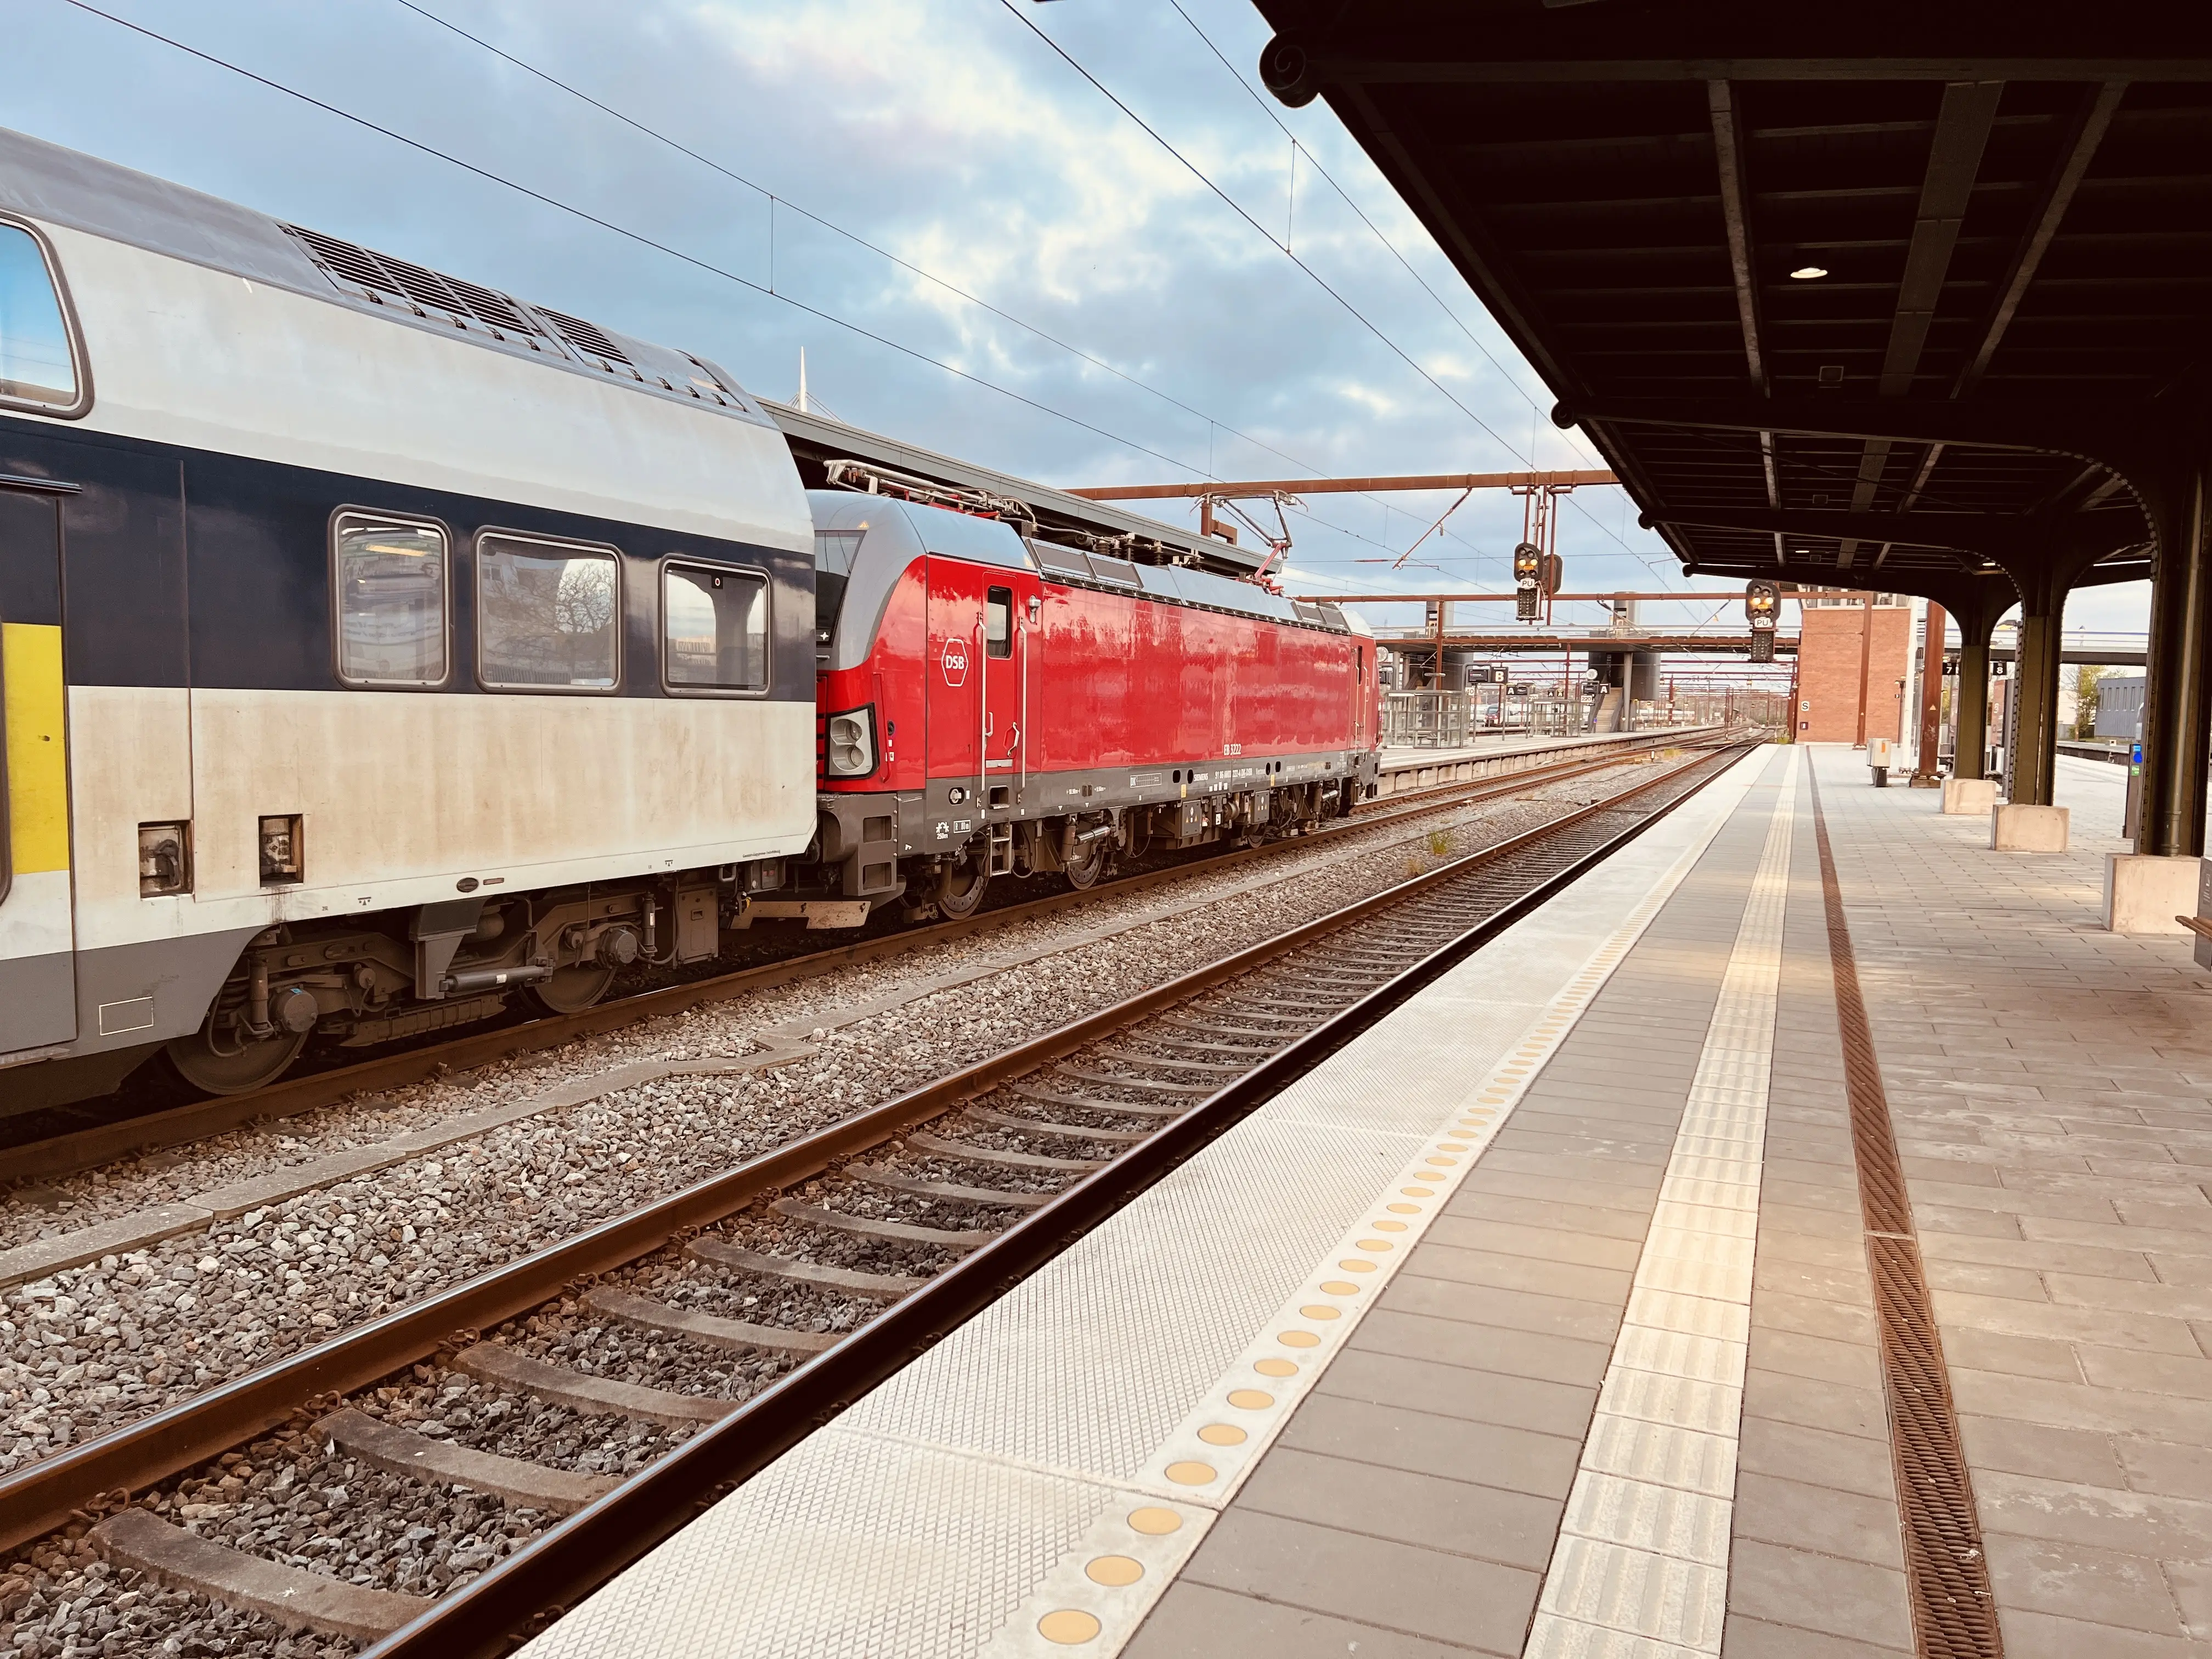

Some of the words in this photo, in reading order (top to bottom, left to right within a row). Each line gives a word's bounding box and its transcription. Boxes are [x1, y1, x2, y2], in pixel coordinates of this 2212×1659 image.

[946, 654, 964, 669] DSB
[1495, 671, 1504, 681] B
[1223, 744, 1230, 756] EB
[1230, 743, 1241, 755] 3222
[1194, 772, 1209, 782] SIEMENS
[955, 822, 958, 831] R
